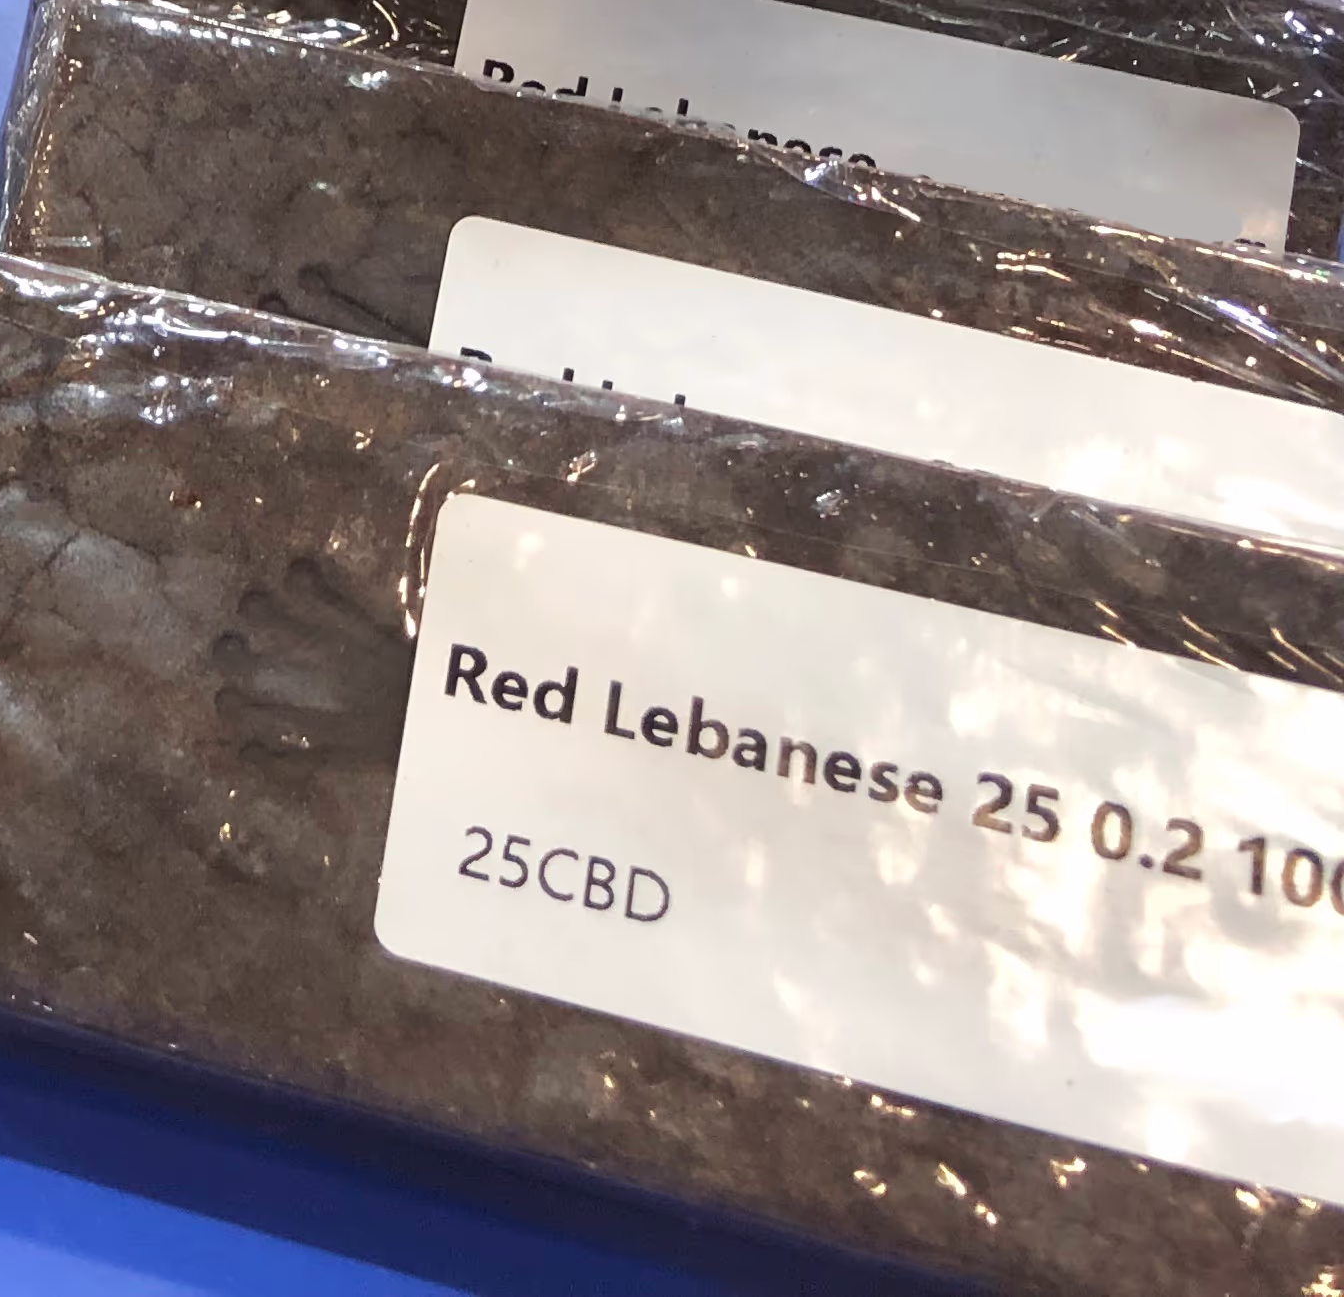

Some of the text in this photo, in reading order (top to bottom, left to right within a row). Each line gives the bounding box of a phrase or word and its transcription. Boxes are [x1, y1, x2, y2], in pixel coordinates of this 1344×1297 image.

[444, 643, 580, 725] Red
[603, 679, 944, 814] Lebanese
[972, 771, 1062, 843] 25
[1090, 800, 1204, 882] 0.2
[458, 826, 671, 923] 25CBD
